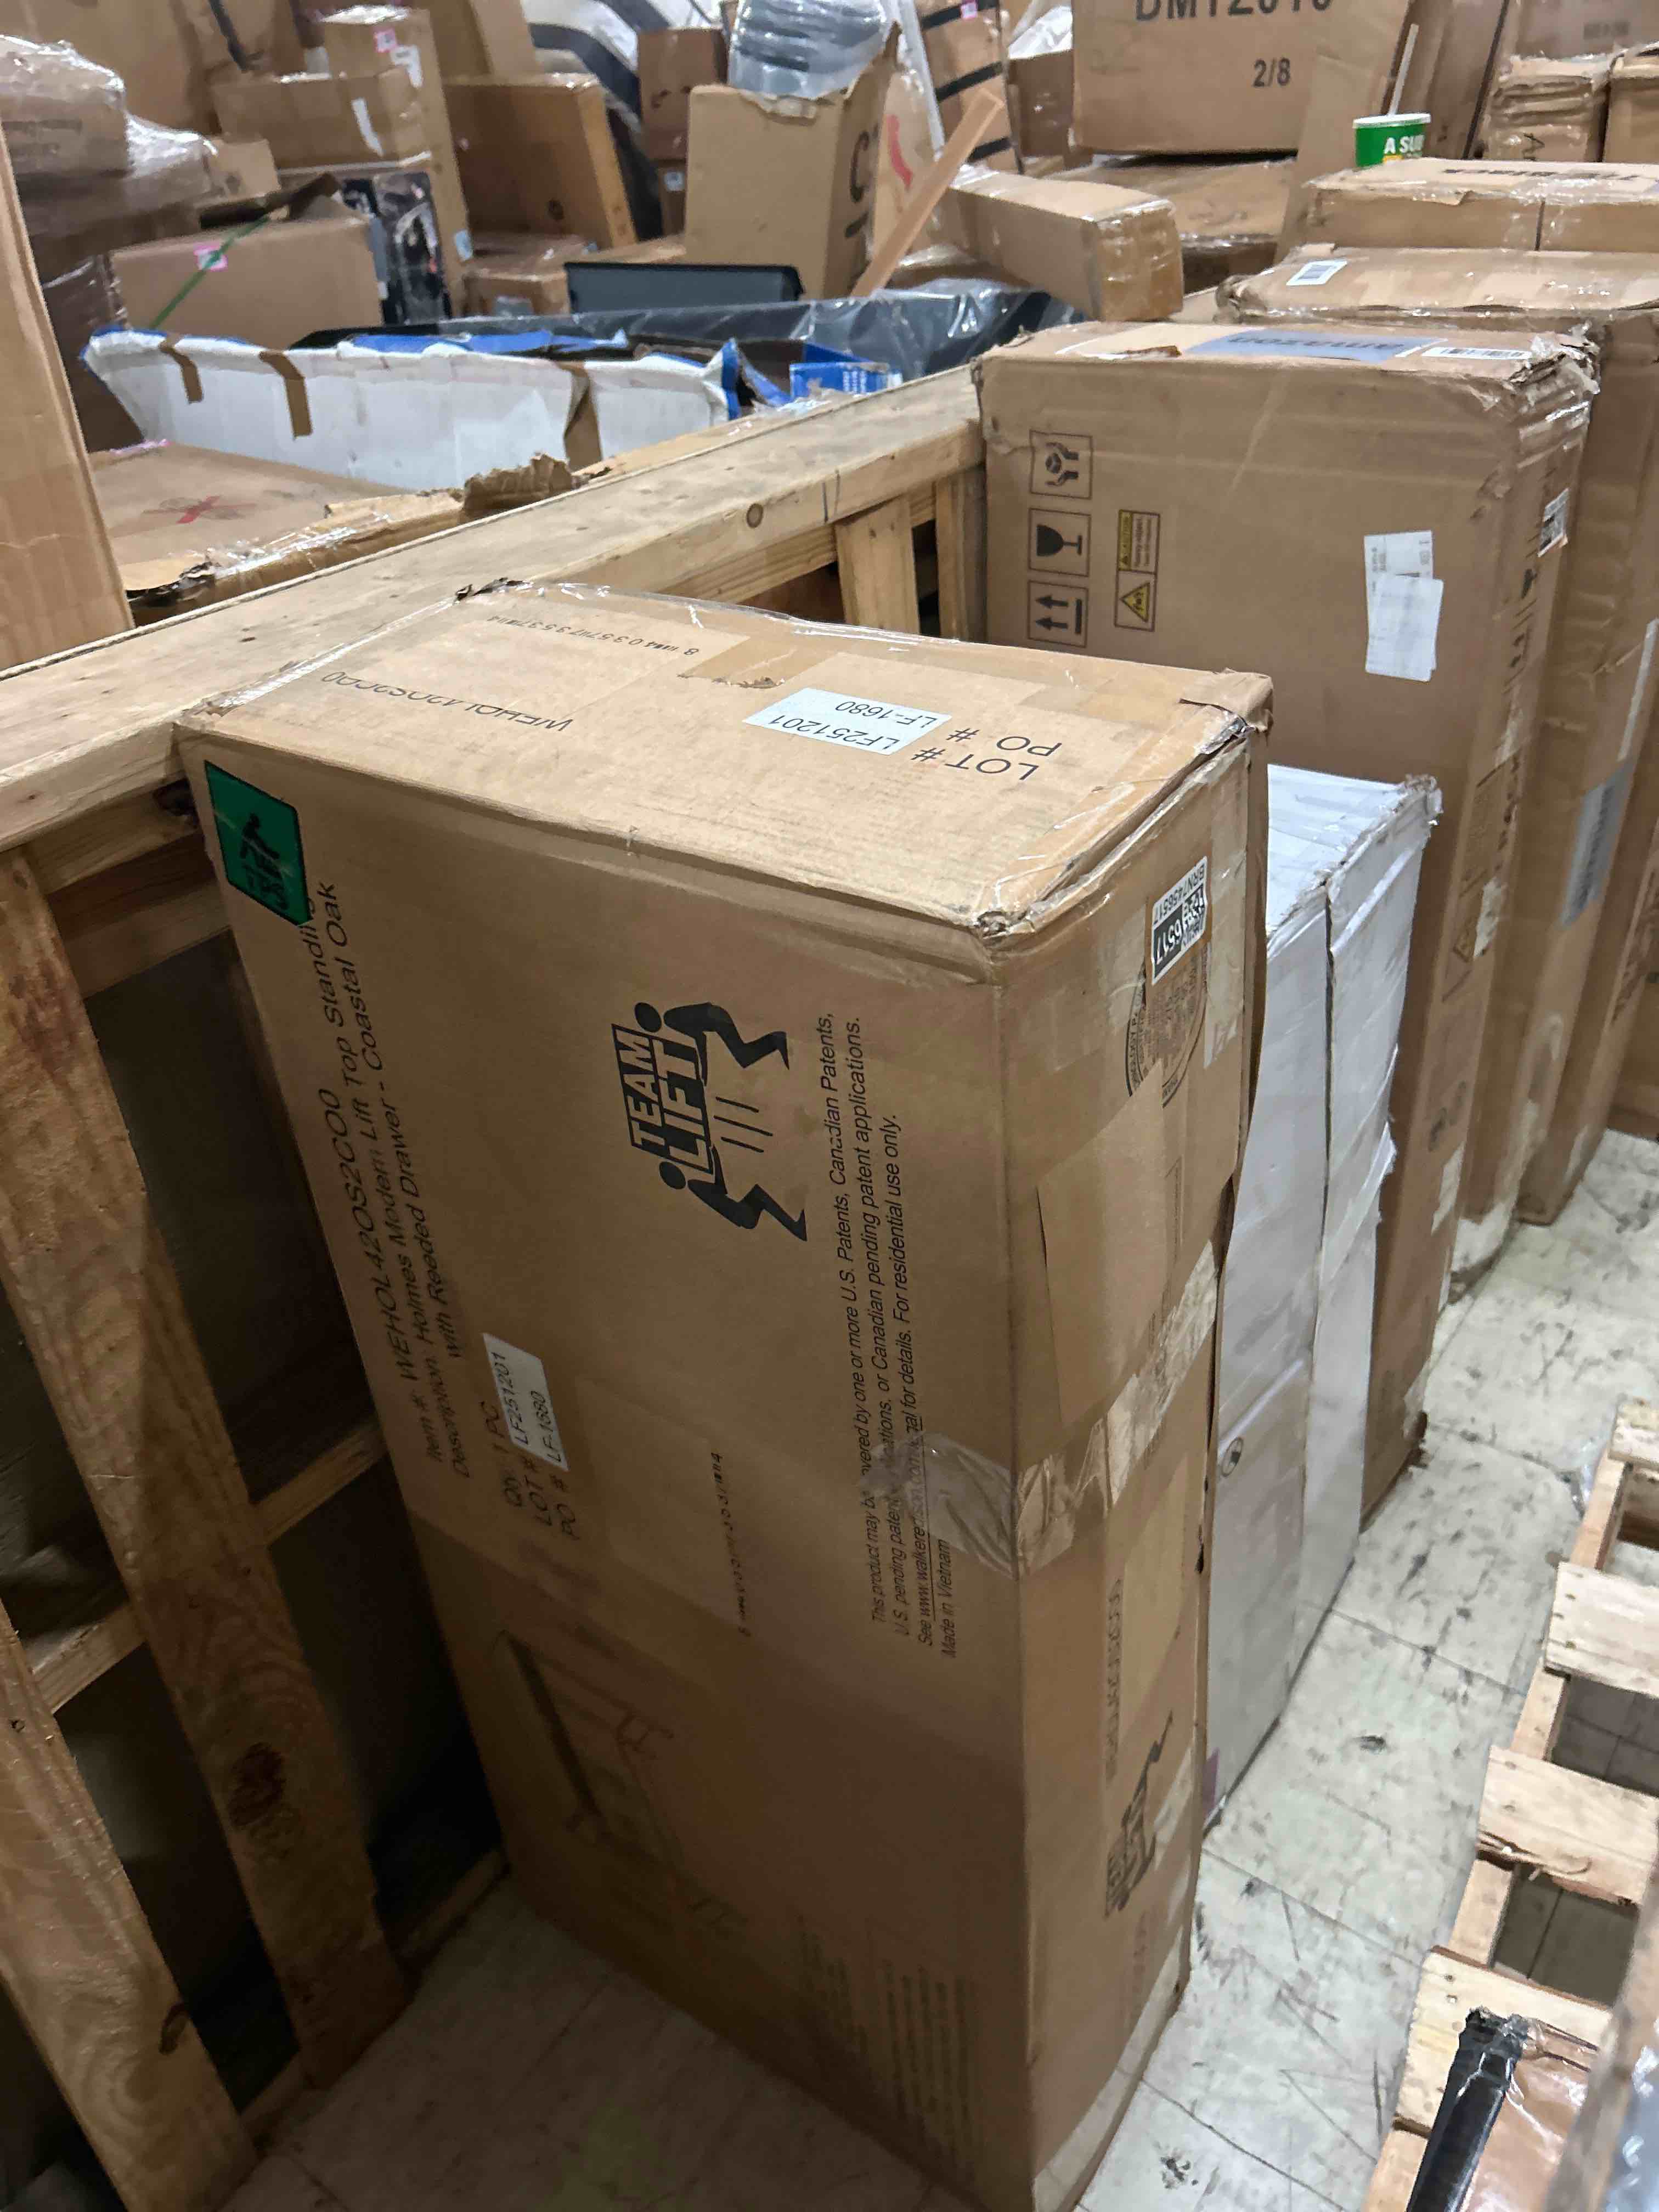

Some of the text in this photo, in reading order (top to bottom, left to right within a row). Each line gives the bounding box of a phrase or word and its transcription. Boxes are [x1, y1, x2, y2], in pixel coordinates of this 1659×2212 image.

[1253, 58, 1291, 87] 2/8
[768, 715, 1039, 780] LOT # LF251201
[835, 702, 1062, 757] PO # LF-1680
[317, 882, 348, 947] Oak
[334, 957, 383, 1070] Coastal
[336, 1036, 366, 1087] Top
[816, 1014, 838, 1092] Patents,
[845, 1018, 872, 1142] applications.
[613, 1025, 668, 1156] TEAM
[650, 1036, 710, 1171] LIFT
[351, 1097, 377, 1141] Lift
[879, 1115, 901, 1158] only.
[379, 1097, 420, 1198] Drawer
[853, 1147, 879, 1209] patent
[887, 1163, 901, 1197] use
[405, 1203, 448, 1306] Reeded
[834, 1194, 853, 1262] Patents,
[860, 1212, 885, 1286] pending
[884, 1200, 907, 1290] residential
[397, 1254, 435, 1345] Holmes
[839, 1269, 857, 1301] U.S.
[893, 1293, 910, 1324] For
[847, 1307, 860, 1349] more
[867, 1289, 888, 1369] Canadian
[850, 1351, 863, 1368] or
[877, 1374, 890, 1391] or
[895, 1330, 914, 1384] details.
[853, 1372, 866, 1402] one
[853, 1404, 871, 1424] by
[900, 1386, 916, 1409] for
[866, 1511, 880, 1542] may
[866, 1544, 885, 1597] product
[889, 1547, 909, 1606] pending
[937, 1539, 952, 1598] Vietnam
[918, 1620, 933, 1646] See
[940, 1619, 957, 1658] Made
